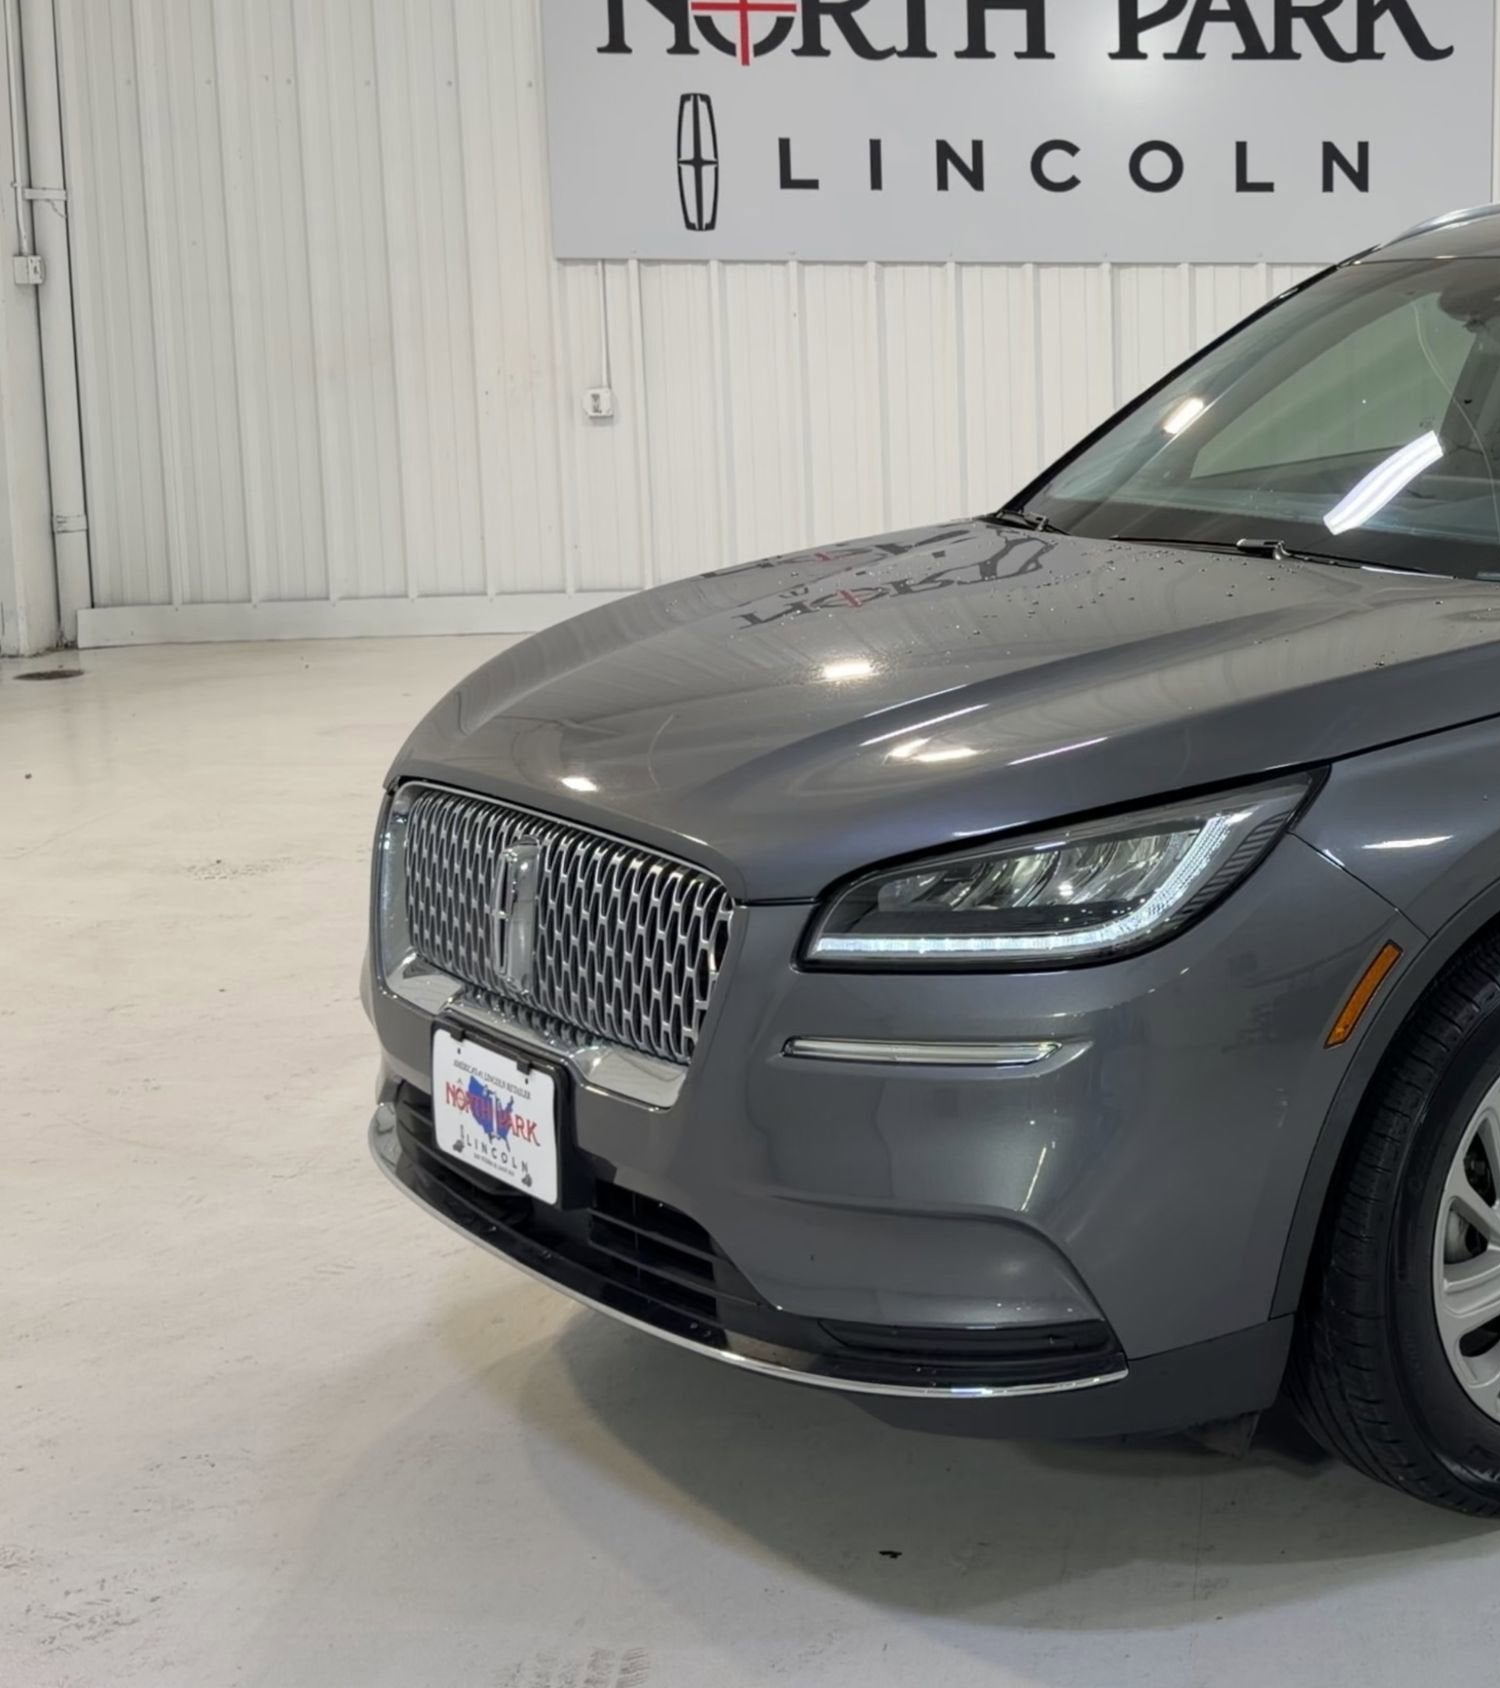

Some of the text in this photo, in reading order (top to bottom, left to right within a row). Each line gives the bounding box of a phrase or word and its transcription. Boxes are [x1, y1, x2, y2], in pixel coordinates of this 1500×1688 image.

[778, 137, 1370, 193] LINCOLN
[446, 1081, 493, 1121] NORTH
[466, 1133, 529, 1173] LINCOLN
